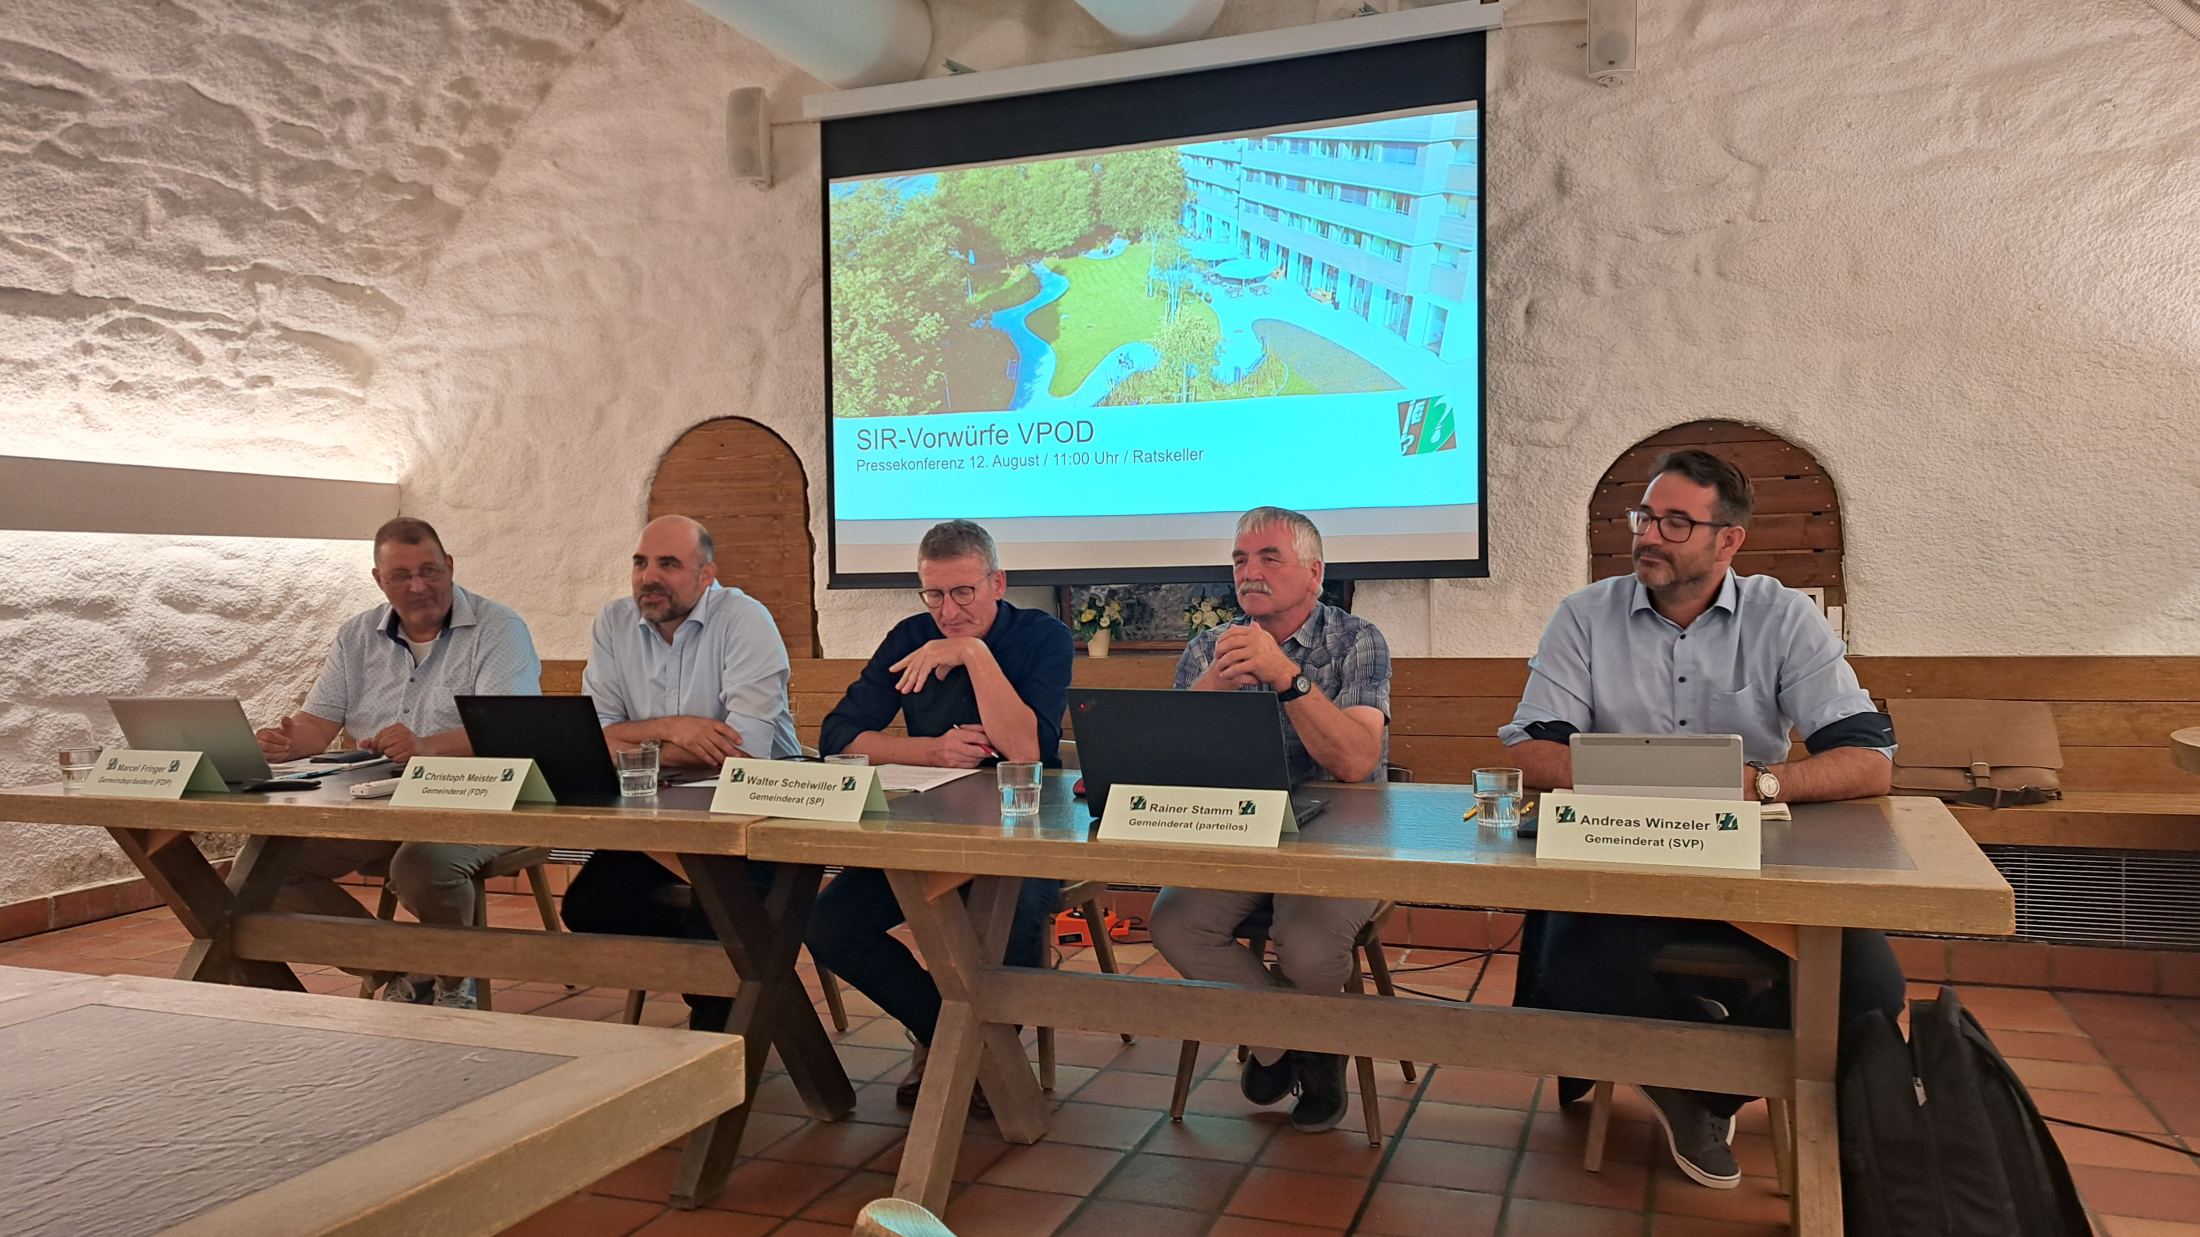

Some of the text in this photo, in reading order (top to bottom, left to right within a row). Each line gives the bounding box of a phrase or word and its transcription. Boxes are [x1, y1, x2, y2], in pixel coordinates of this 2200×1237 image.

[857, 421, 1095, 450] SIR-Vorwürfe VPOD
[857, 448, 1205, 472] Pressekonferenz 12. August / 11:00 Uhr / Ratskeller
[117, 763, 166, 774] Marcel Fringer
[98, 776, 172, 788] Gemeindepräsident (FDP)
[424, 772, 498, 783] Christoph Meister
[747, 775, 838, 792] Walter Scheiwiller
[421, 787, 488, 798] Gemeinderat (FDP)
[749, 792, 825, 807] Gemeinderat (SP)
[1149, 803, 1233, 816] Rainer Stamm
[1128, 818, 1248, 832] Gemeinderat (parteilos)
[1580, 815, 1711, 831] Andreas Winzeler
[1584, 834, 1704, 851] Gemeinderat (SVP)
